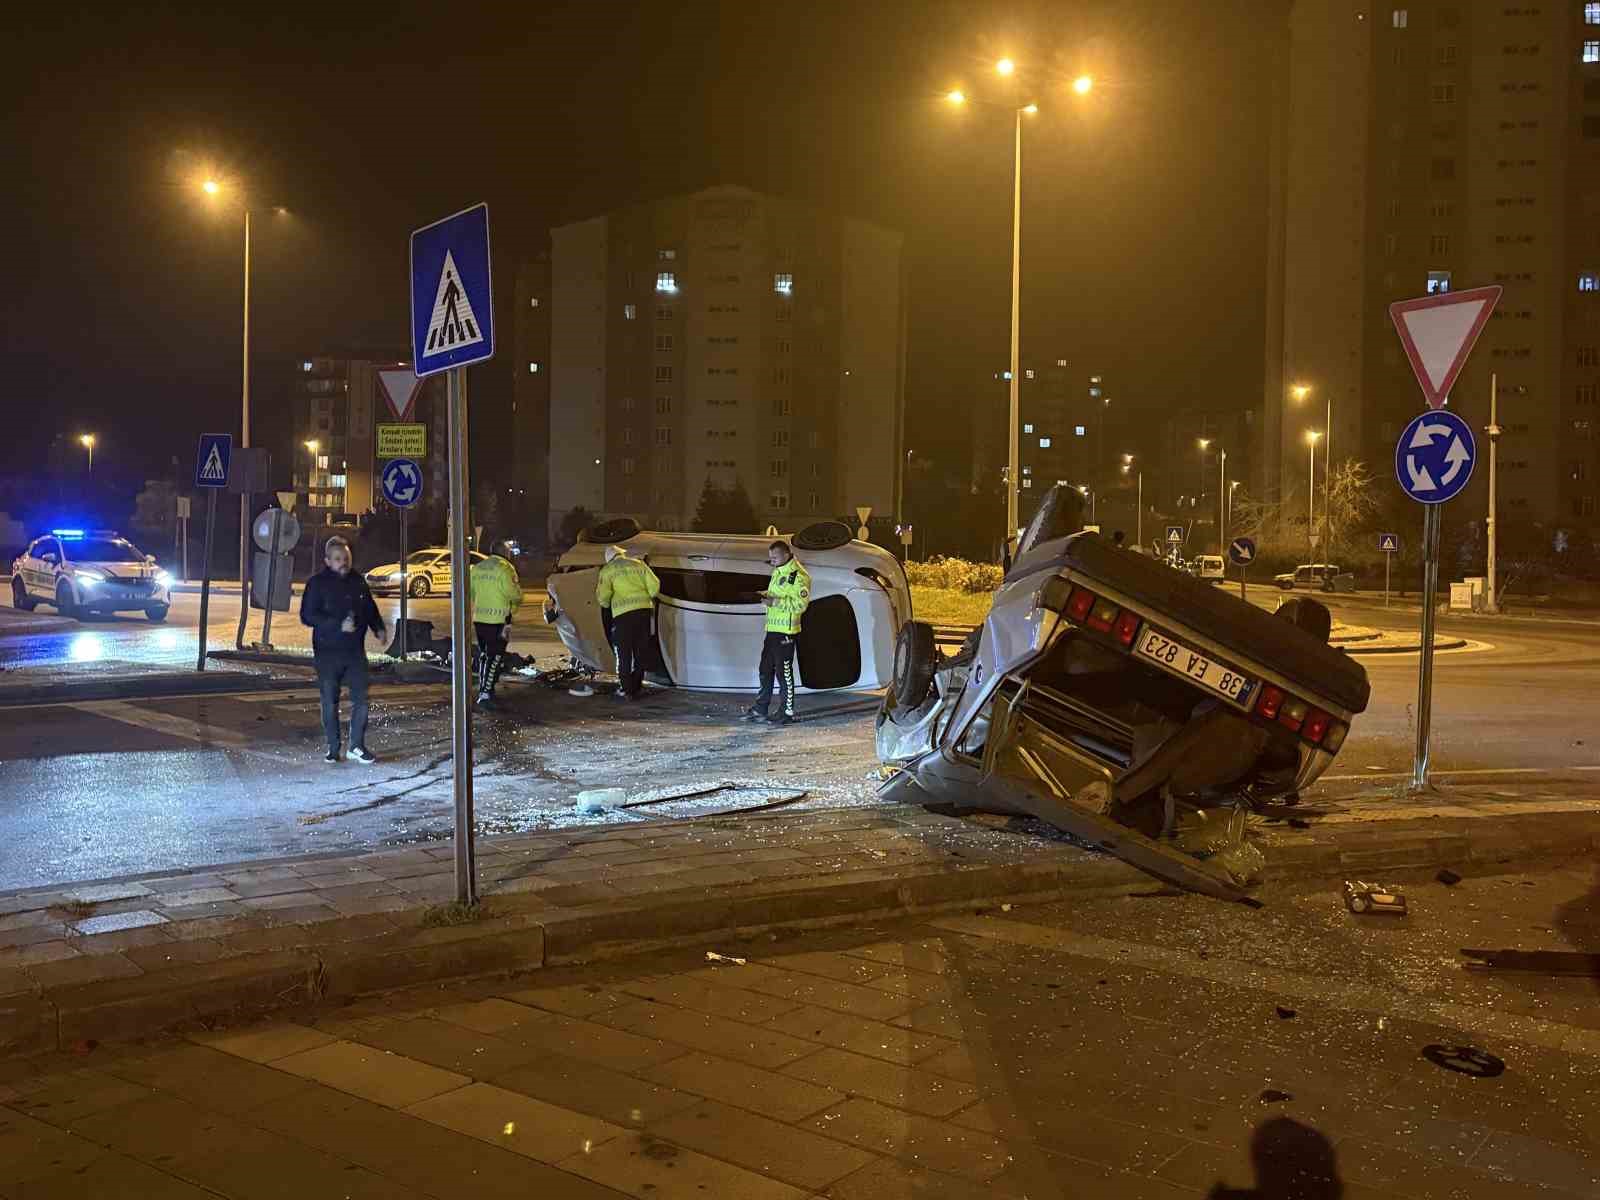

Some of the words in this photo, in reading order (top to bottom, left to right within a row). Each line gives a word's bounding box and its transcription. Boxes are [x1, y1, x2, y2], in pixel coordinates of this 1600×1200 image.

[1145, 635, 1178, 662] 823
[1186, 653, 1208, 679] EA
[1219, 672, 1242, 695] 38
